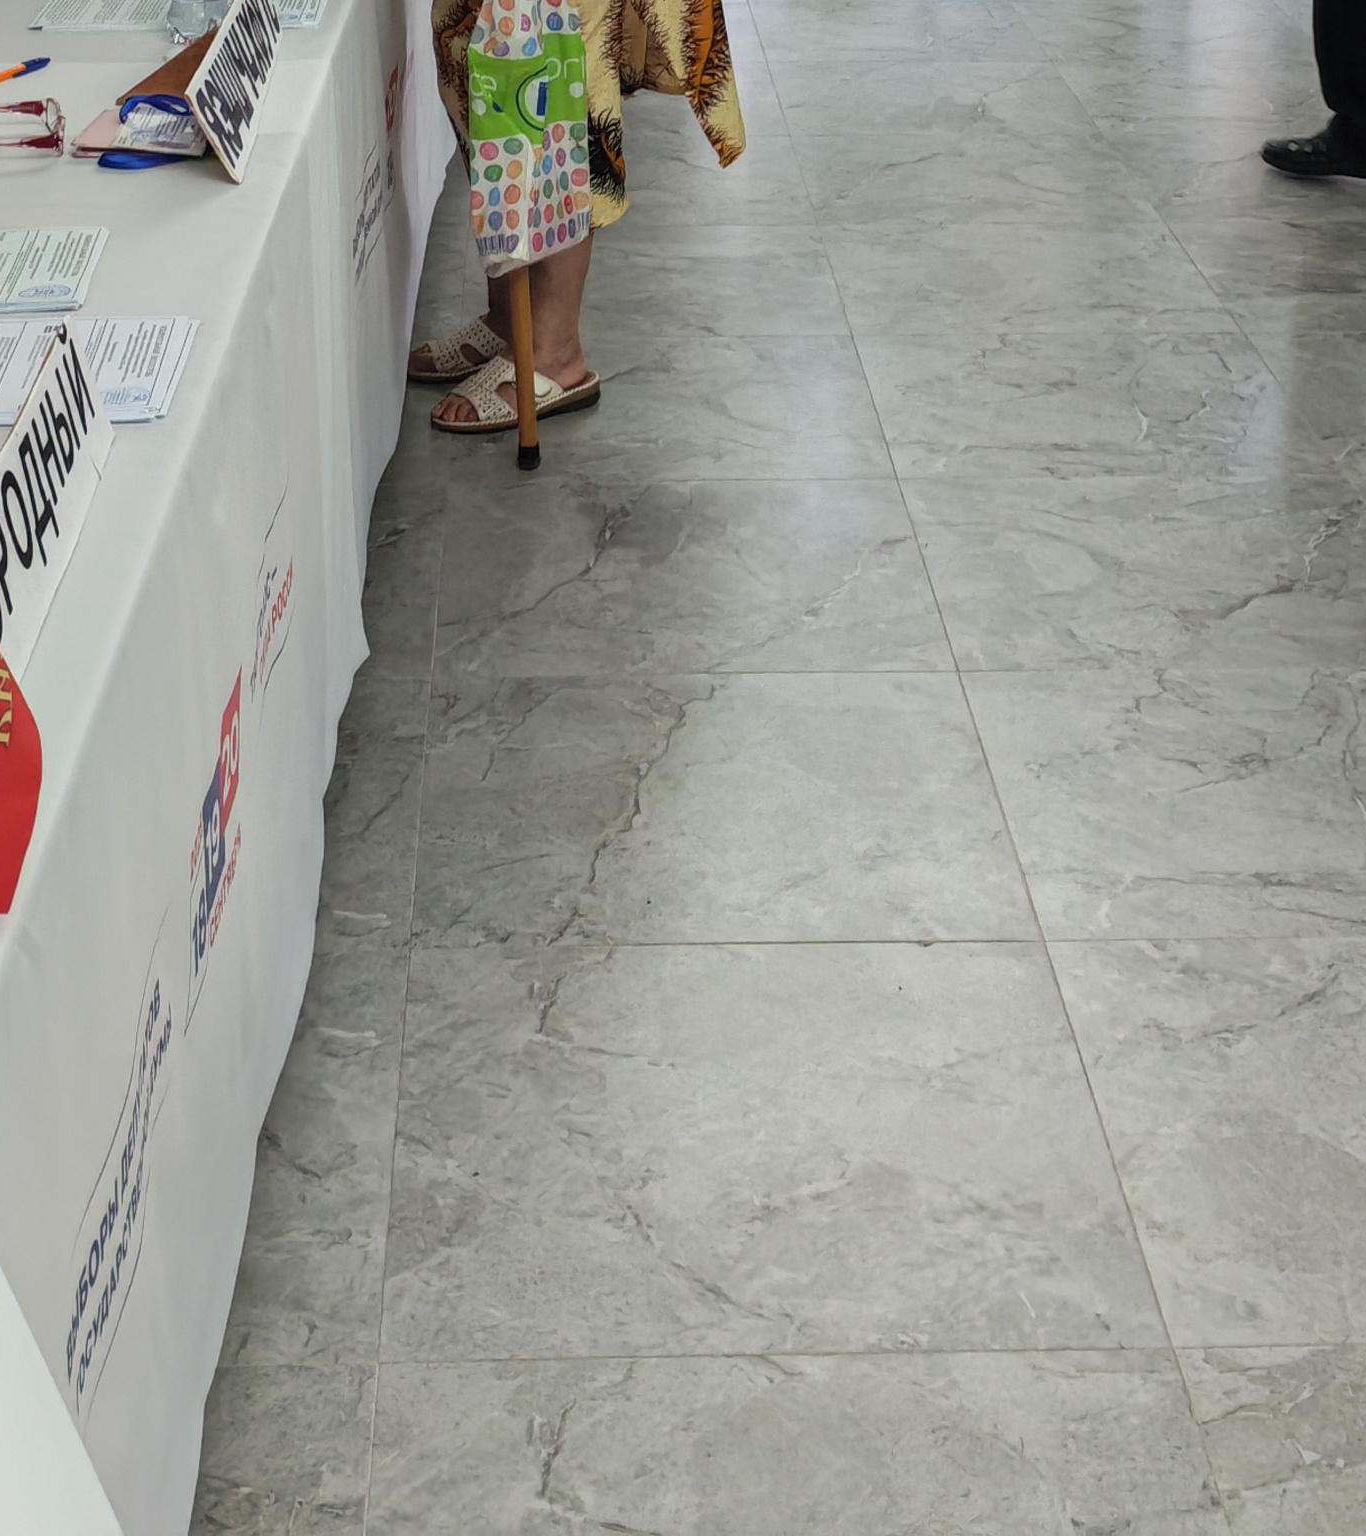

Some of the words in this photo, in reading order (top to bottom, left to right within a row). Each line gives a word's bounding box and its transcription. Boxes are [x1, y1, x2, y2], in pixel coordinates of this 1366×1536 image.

[192, 888, 207, 978] 18
[206, 799, 221, 886] 19
[222, 710, 240, 804] 20
[66, 1177, 119, 1385] ВЫБОРЫ
